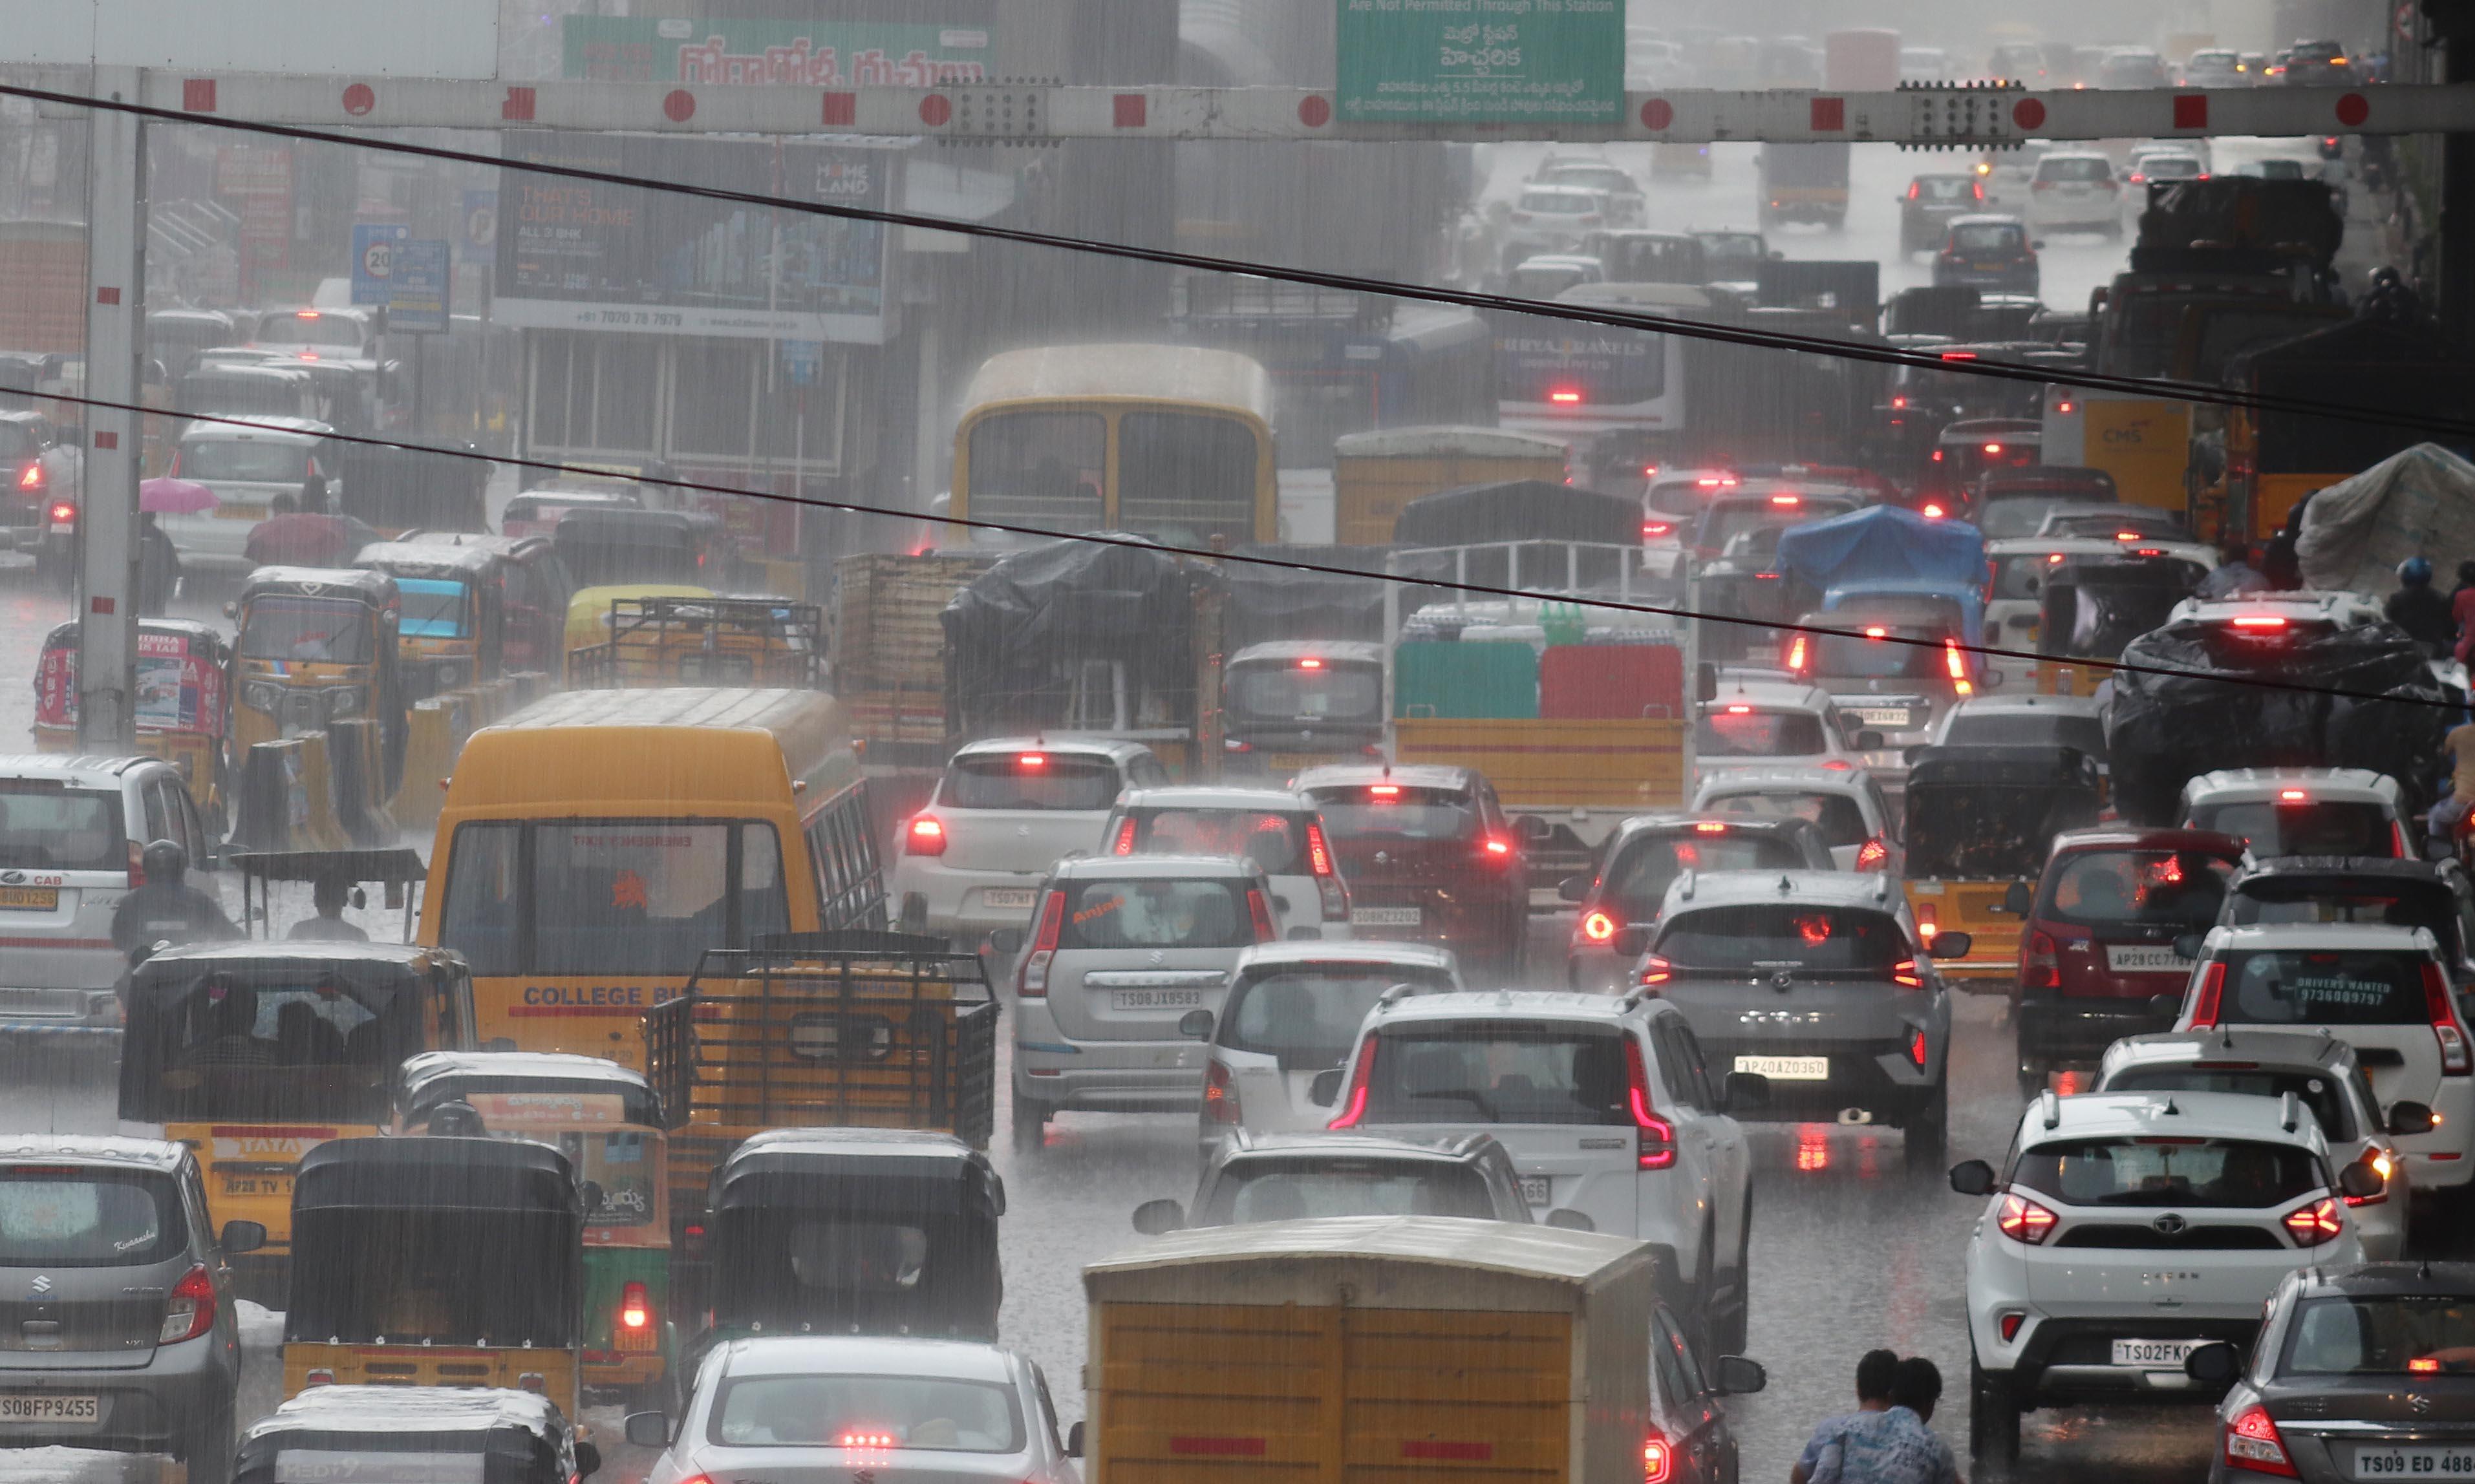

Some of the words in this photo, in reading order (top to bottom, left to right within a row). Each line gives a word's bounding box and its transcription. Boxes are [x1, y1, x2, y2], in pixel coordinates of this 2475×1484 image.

[1349, 0, 1371, 11] Are
[1377, 0, 1400, 11] Not
[1405, 0, 1472, 12] Permitted
[1476, 0, 1530, 14] Through
[1536, 0, 1561, 12] This
[1565, 0, 1614, 12] Station
[1453, 82, 1470, 93] 5.5
[816, 180, 868, 194] LAND
[520, 205, 564, 222] OUR
[573, 208, 634, 226] HOME
[519, 226, 539, 237] ALL
[2103, 427, 2142, 443] CMS
[34, 876, 62, 885] CAB
[2298, 977, 2344, 990] DRIVERS
[2348, 980, 2391, 993] WANTED
[524, 987, 642, 1006] COLLEGE
[1744, 1061, 1824, 1074] AP40AZ0360
[242, 1138, 297, 1153] TATA
[3, 1399, 95, 1417] S08FP9455
[2361, 1456, 2405, 1472] TS09
[2412, 1456, 2434, 1472] ED
[2441, 1456, 2475, 1472] 488
